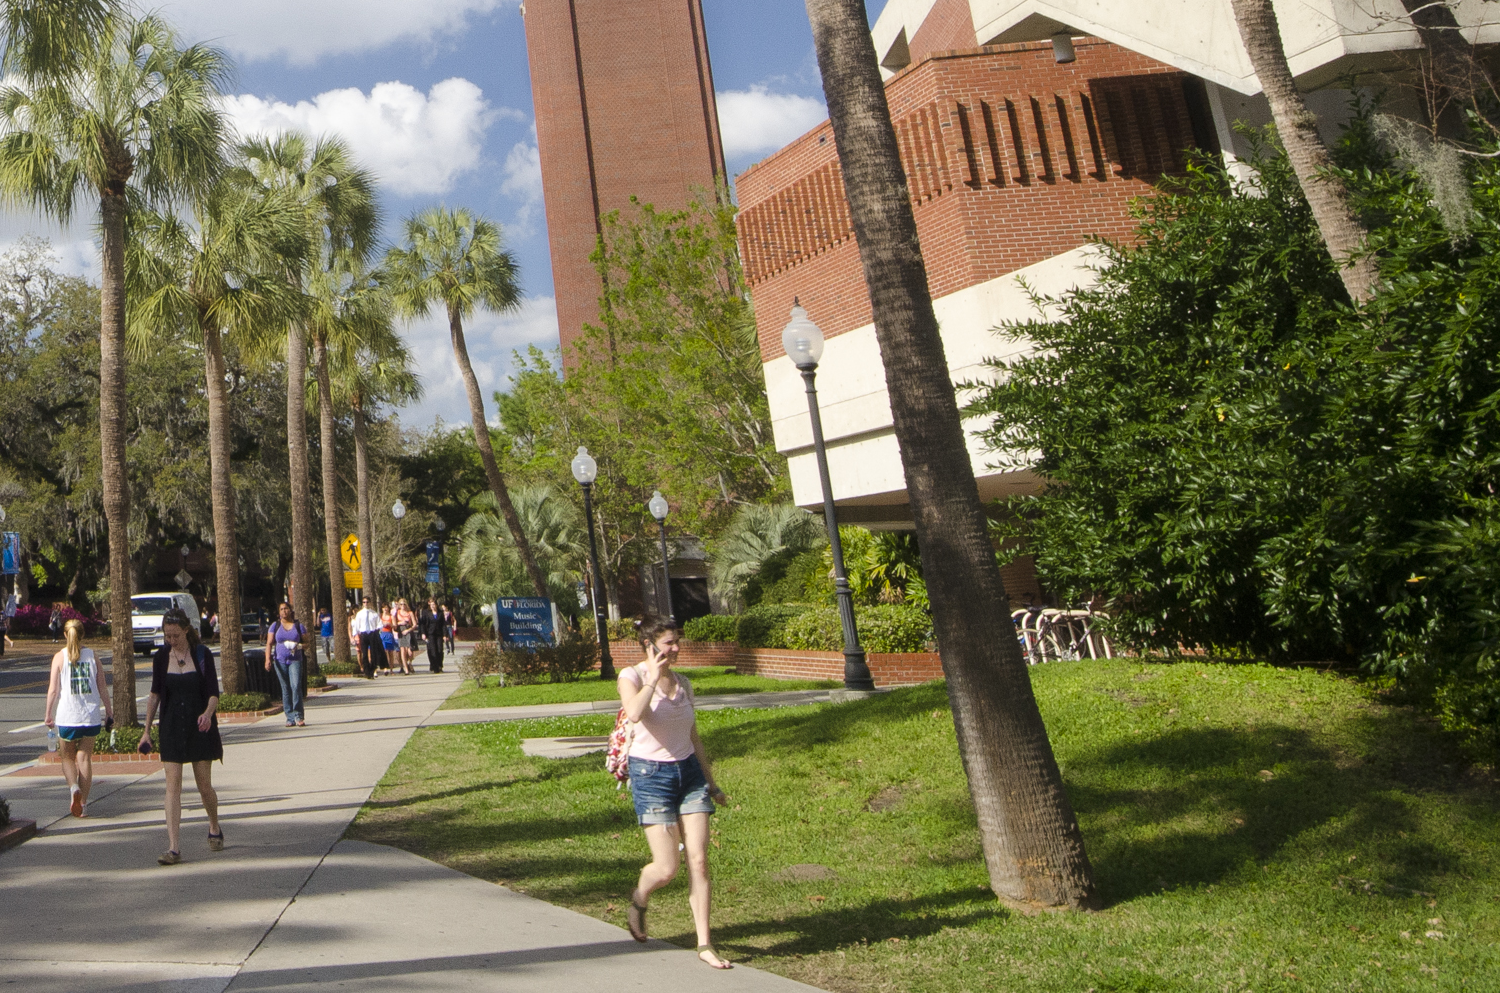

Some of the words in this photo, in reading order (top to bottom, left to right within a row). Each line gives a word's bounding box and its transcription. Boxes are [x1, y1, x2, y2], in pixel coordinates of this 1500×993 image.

[501, 599, 514, 608] UF
[513, 612, 537, 620] Music
[510, 622, 542, 631] Building
